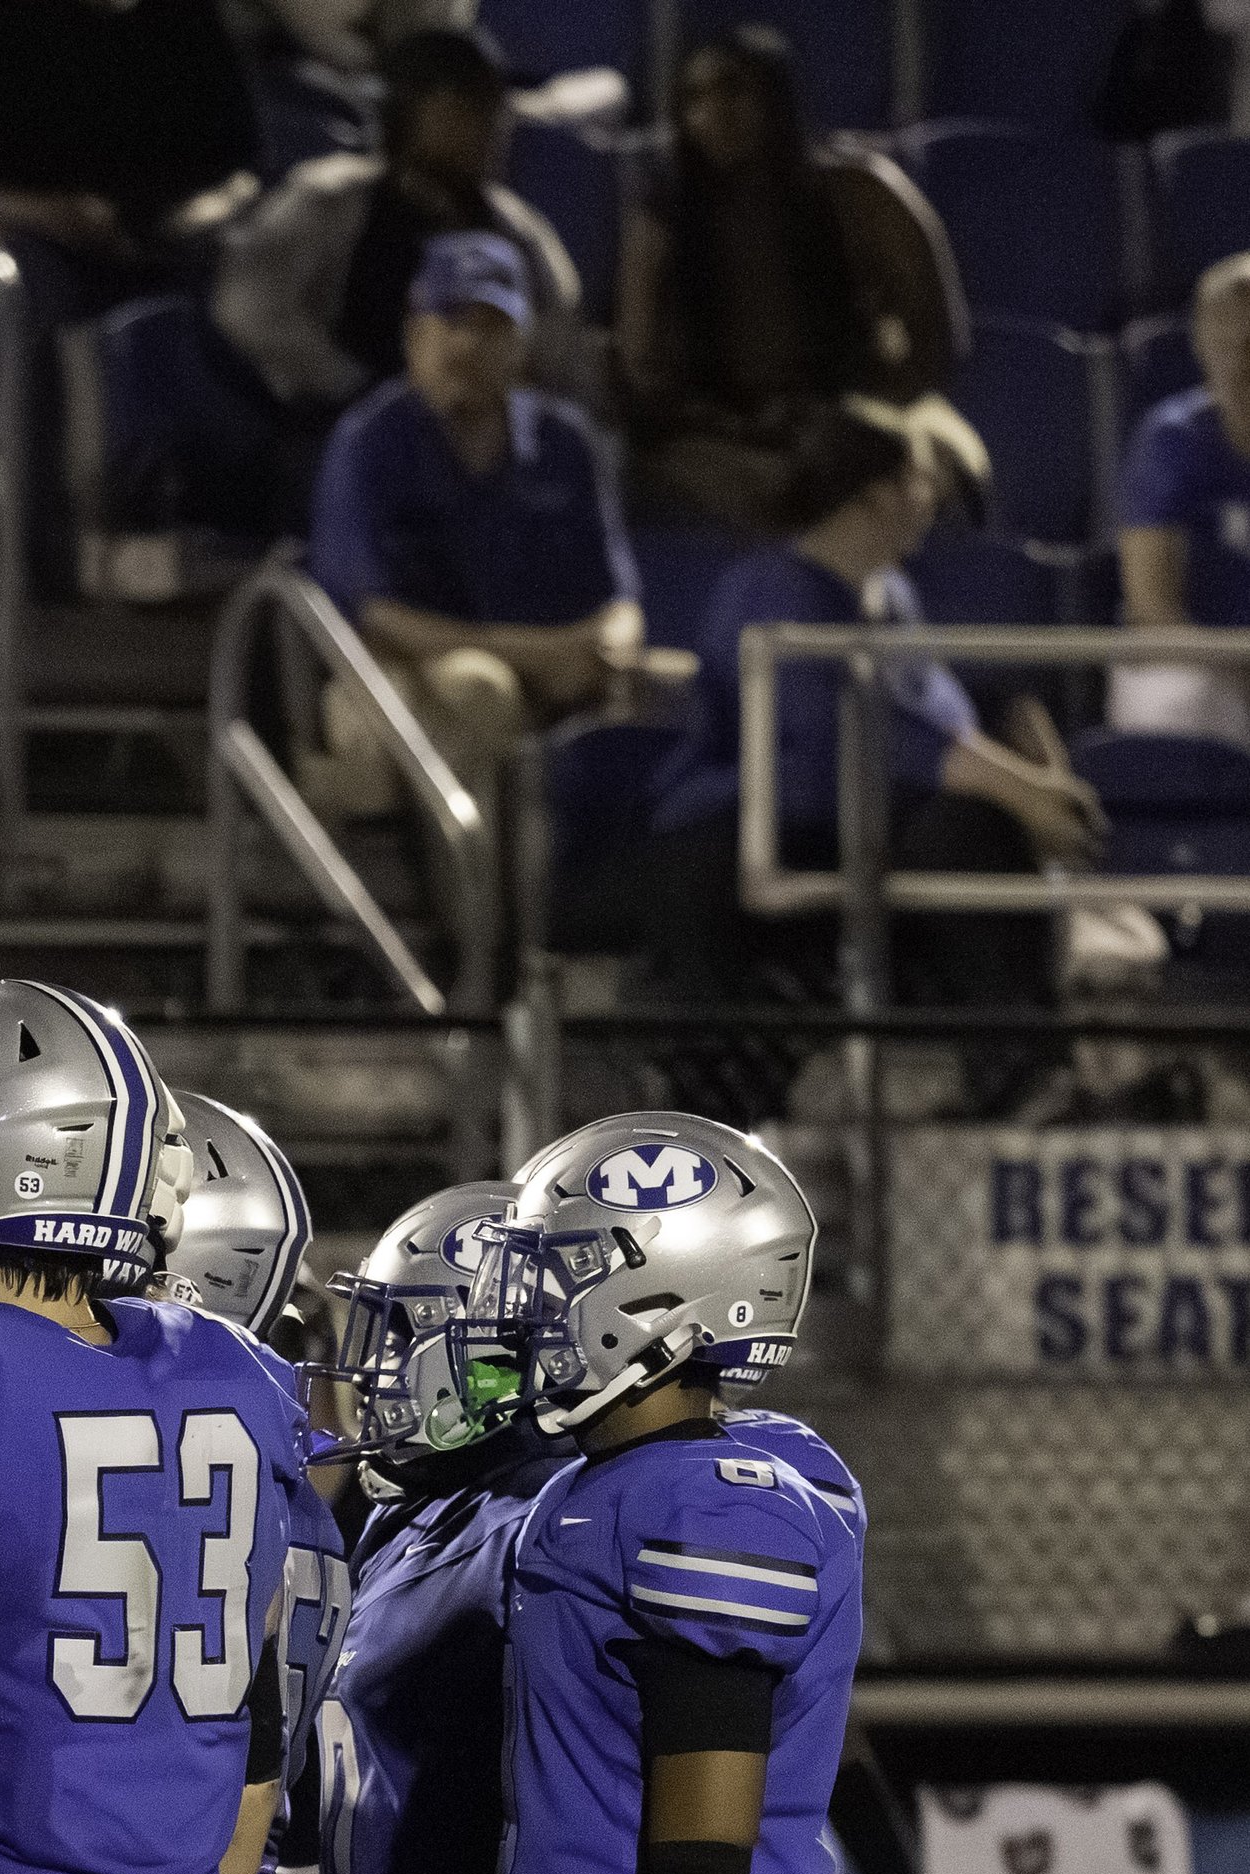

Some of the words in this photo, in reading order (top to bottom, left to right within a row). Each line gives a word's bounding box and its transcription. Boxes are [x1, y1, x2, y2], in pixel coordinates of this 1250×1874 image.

[19, 1176, 41, 1194] 53
[600, 1145, 703, 1207] M
[990, 1156, 1250, 1247] RESE
[33, 1219, 113, 1249] HARD
[736, 1305, 747, 1323] 8
[47, 1407, 261, 1724] 53
